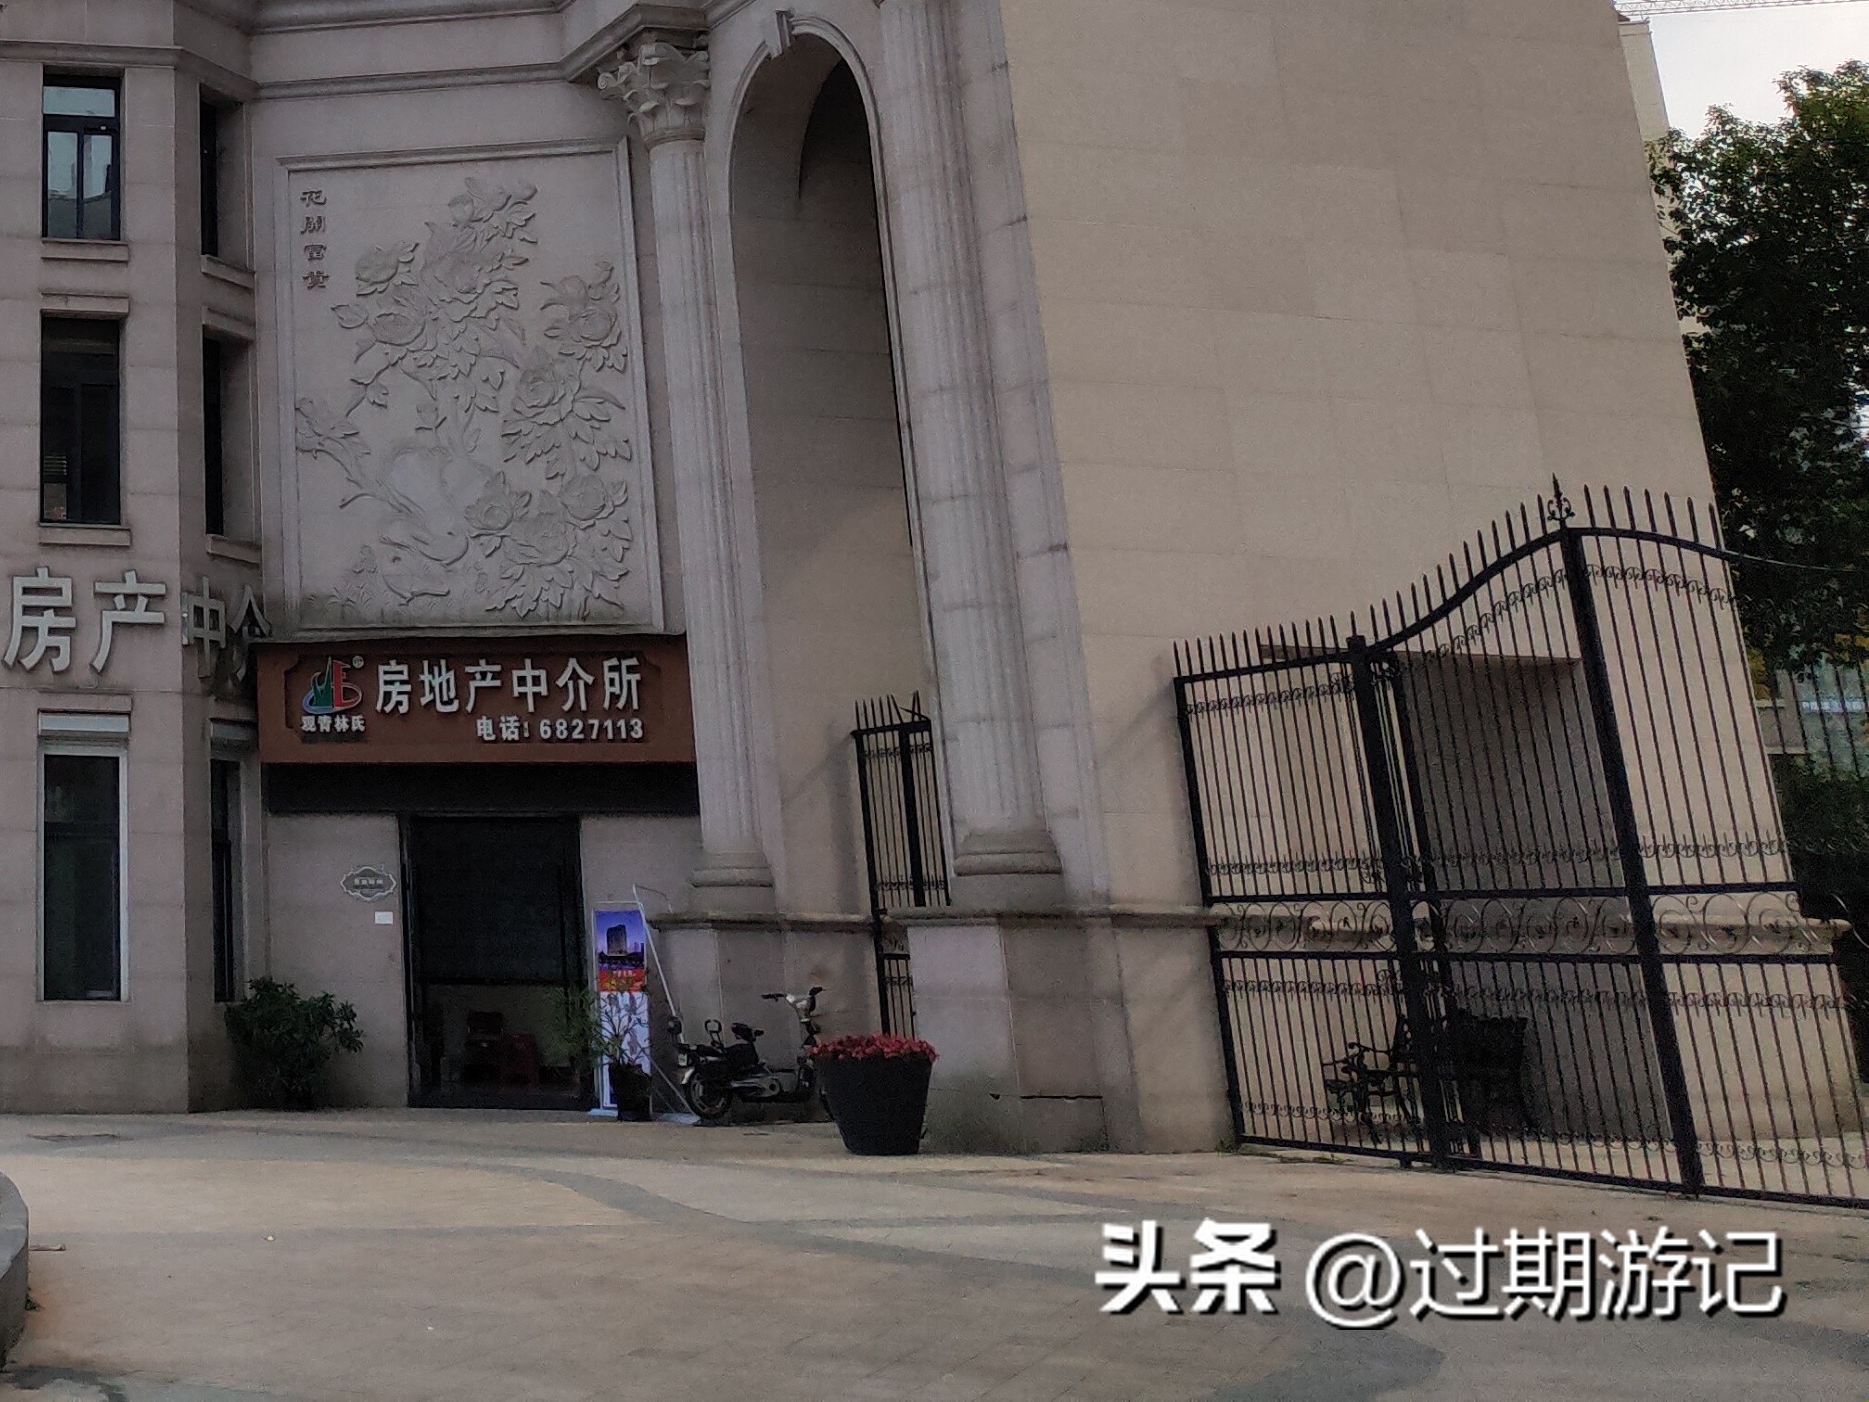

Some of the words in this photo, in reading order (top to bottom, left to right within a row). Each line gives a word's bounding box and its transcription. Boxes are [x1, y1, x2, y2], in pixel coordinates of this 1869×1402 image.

[375, 657, 642, 715] 房地产中介所
[301, 713, 366, 733] 观青林氏
[539, 717, 643, 740] 6827113
